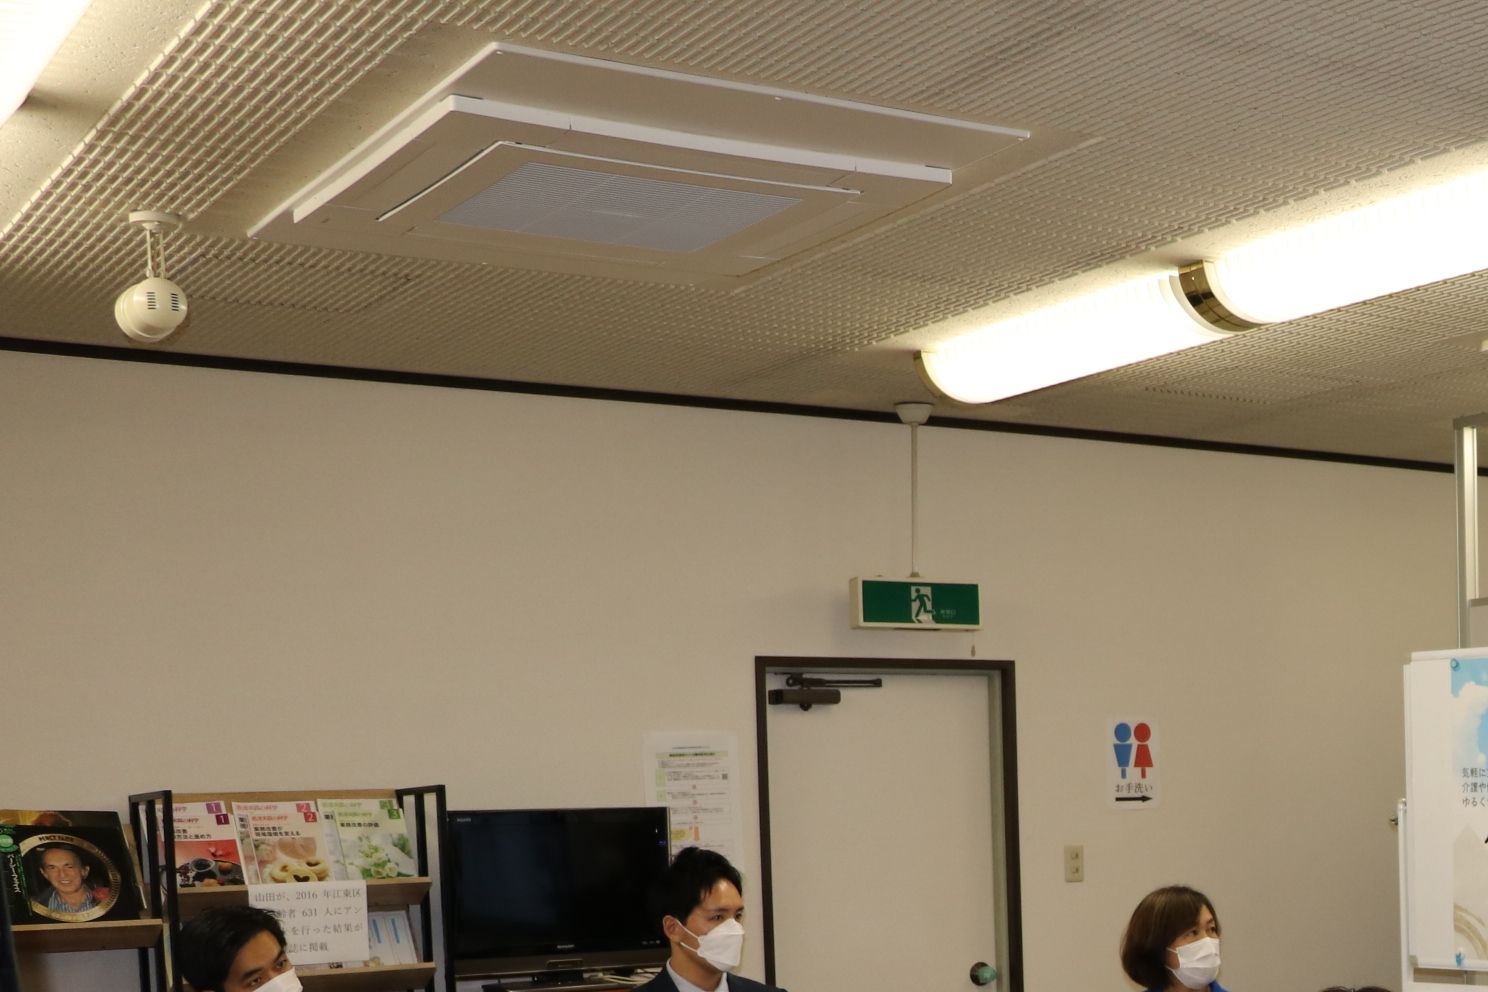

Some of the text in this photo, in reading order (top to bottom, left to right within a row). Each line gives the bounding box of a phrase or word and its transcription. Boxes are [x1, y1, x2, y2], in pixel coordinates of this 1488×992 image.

[1114, 782, 1153, 794] お手洗い
[283, 922, 364, 936] を行った結果が
